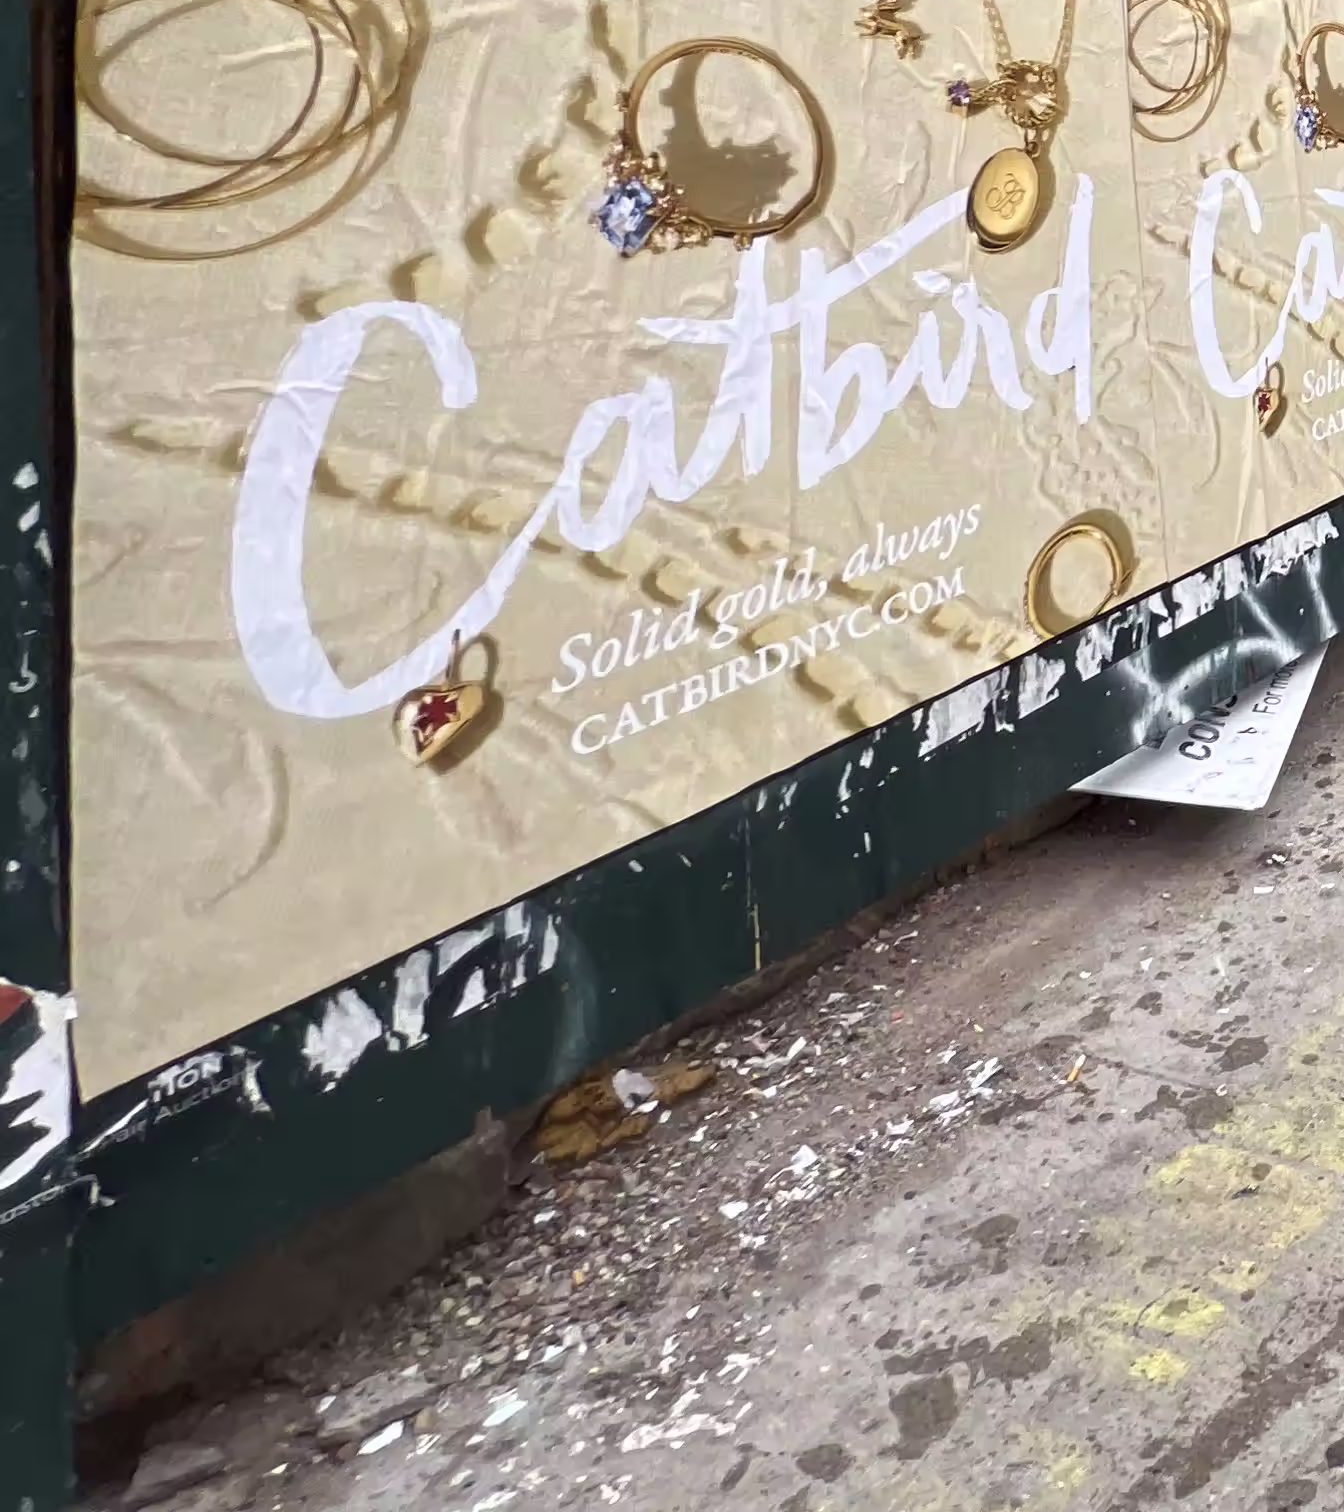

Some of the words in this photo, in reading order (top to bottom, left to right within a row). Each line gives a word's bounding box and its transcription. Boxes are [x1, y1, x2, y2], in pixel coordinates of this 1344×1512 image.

[229, 173, 1094, 719] Catbird
[551, 592, 701, 694] Solid
[708, 547, 829, 651] gold,
[841, 502, 982, 582] always
[570, 566, 967, 756] CATBIRDNYC.COM
